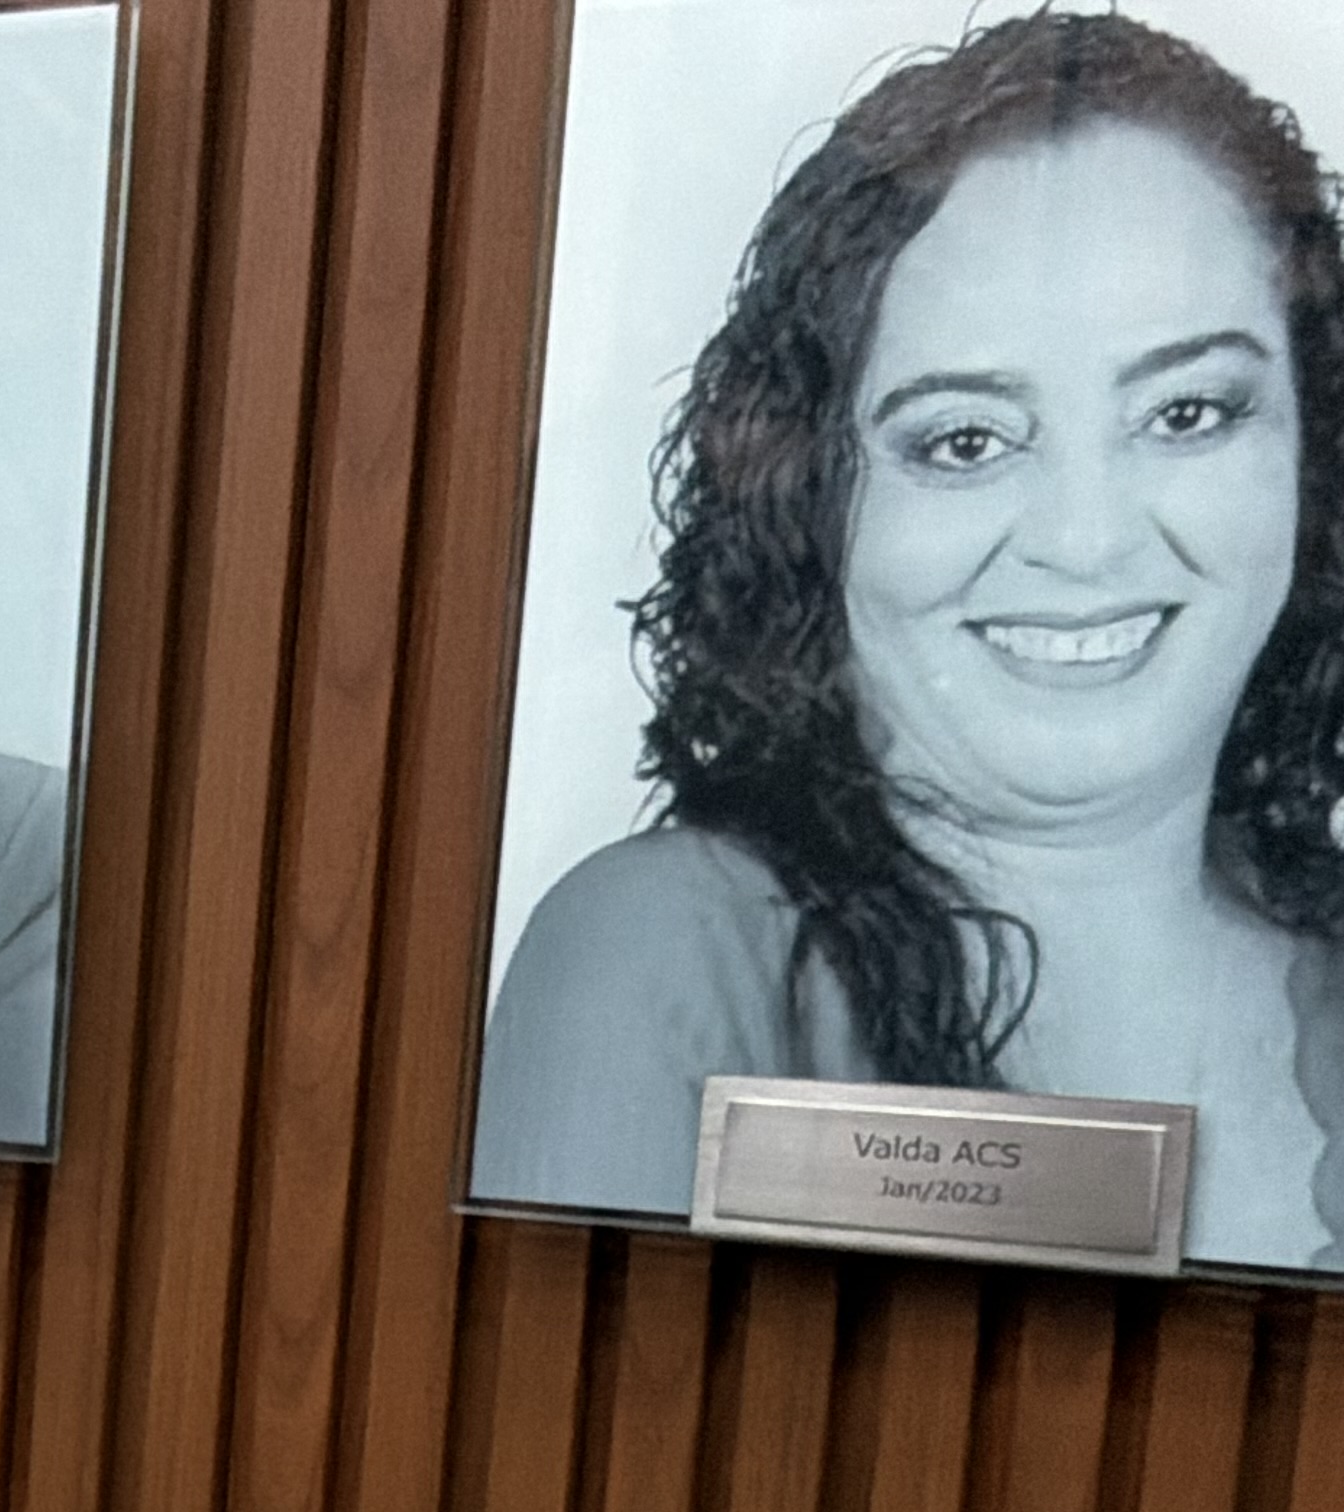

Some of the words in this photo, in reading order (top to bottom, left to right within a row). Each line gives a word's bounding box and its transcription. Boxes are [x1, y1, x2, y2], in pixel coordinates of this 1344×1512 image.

[853, 1132, 941, 1163] Valda
[952, 1140, 1022, 1169] ACS
[879, 1176, 1002, 1206] Jan/2023
